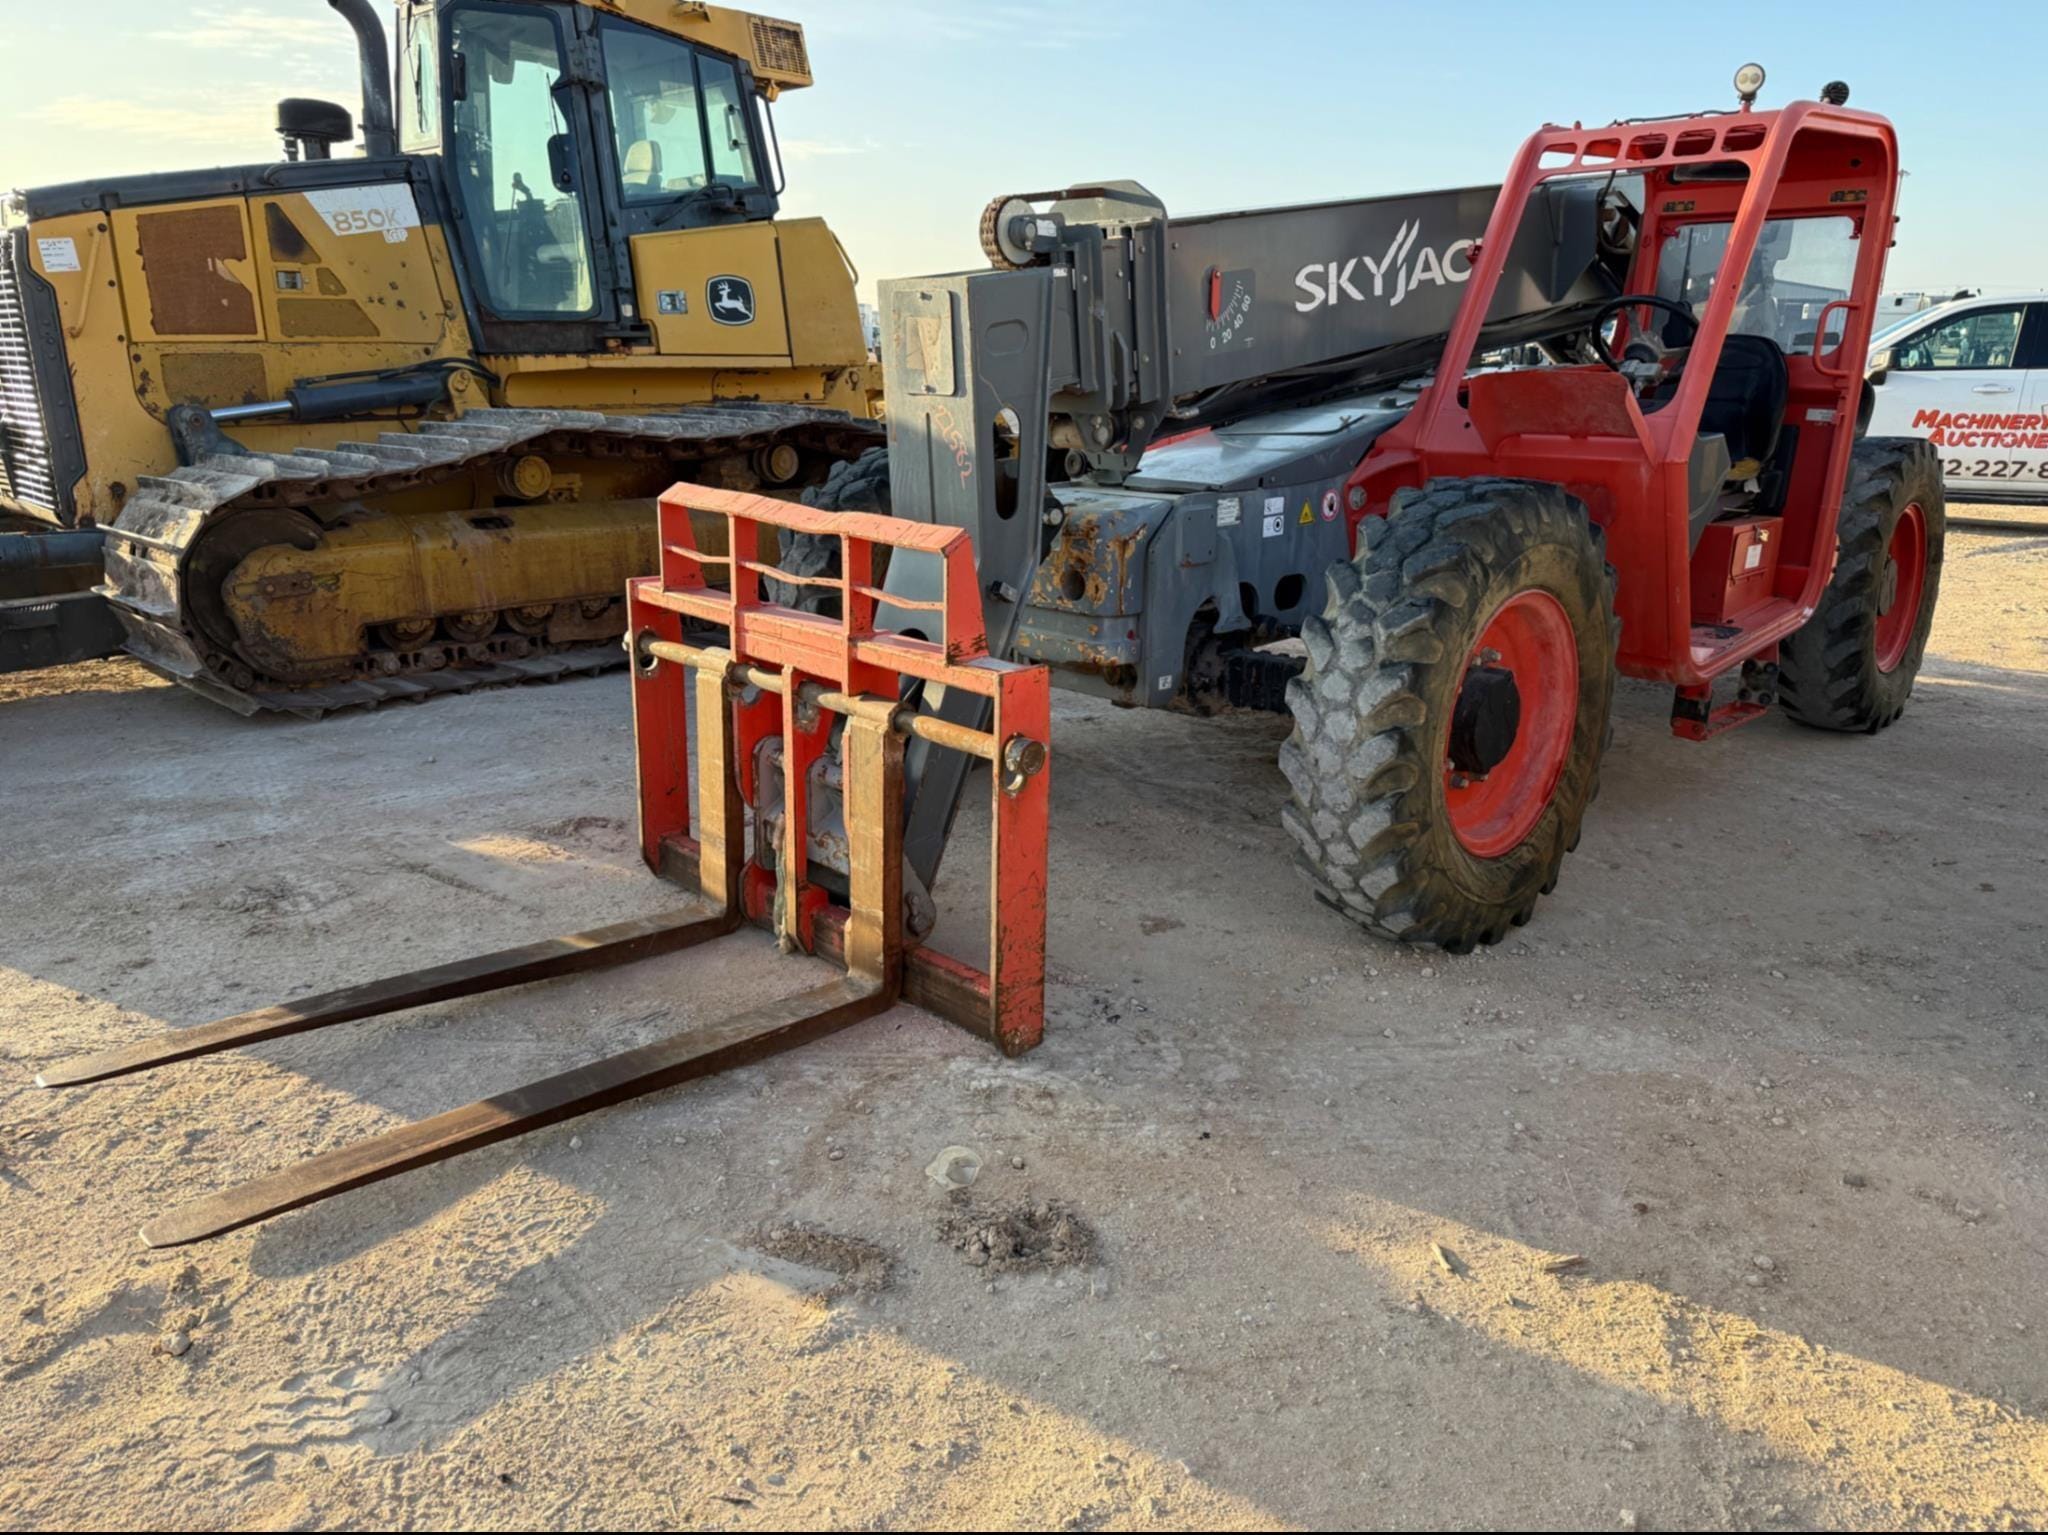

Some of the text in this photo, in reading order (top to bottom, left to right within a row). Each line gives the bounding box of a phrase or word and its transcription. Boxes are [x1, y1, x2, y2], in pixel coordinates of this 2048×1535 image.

[332, 208, 401, 232] 850K
[1295, 218, 1503, 312] SKYJAC
[1209, 294, 1252, 350] 0 20 40 60
